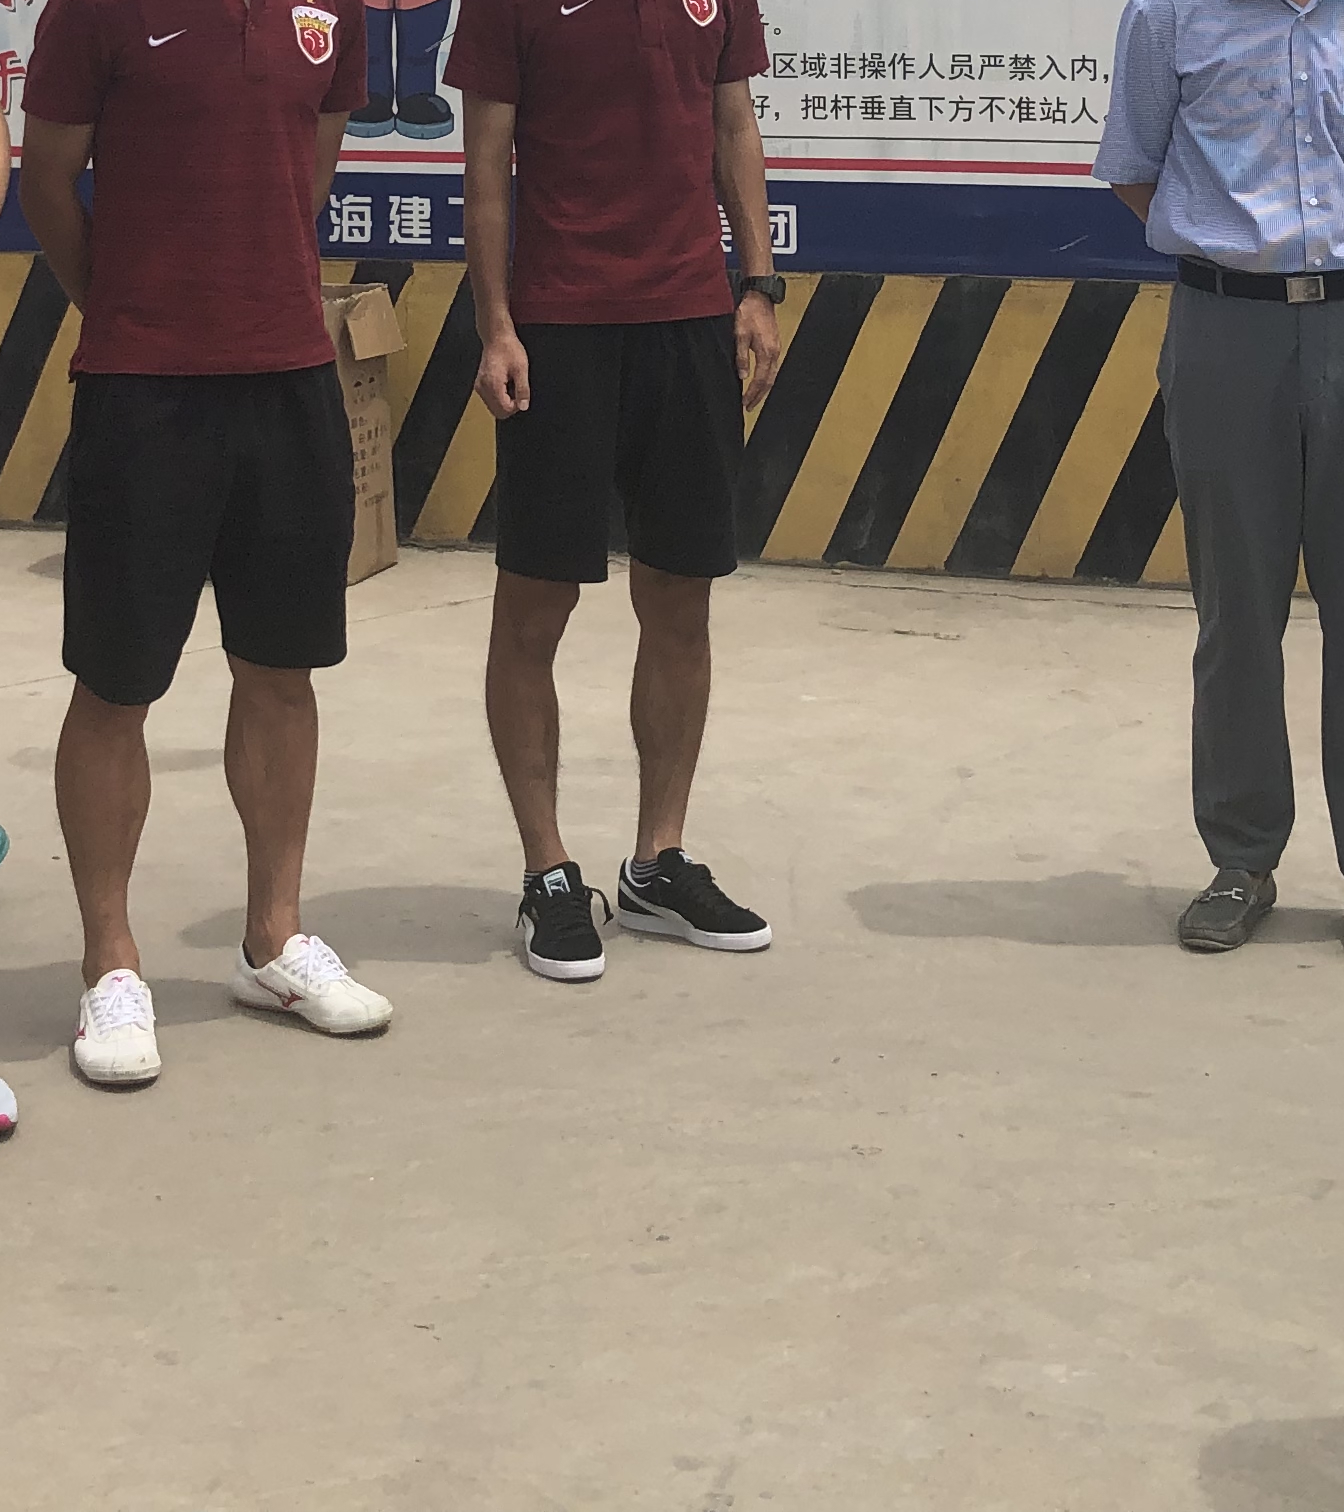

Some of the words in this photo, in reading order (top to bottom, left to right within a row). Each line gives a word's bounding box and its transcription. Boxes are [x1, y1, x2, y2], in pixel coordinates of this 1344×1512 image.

[759, 52, 1110, 84] 区域非操作人员严禁入内，
